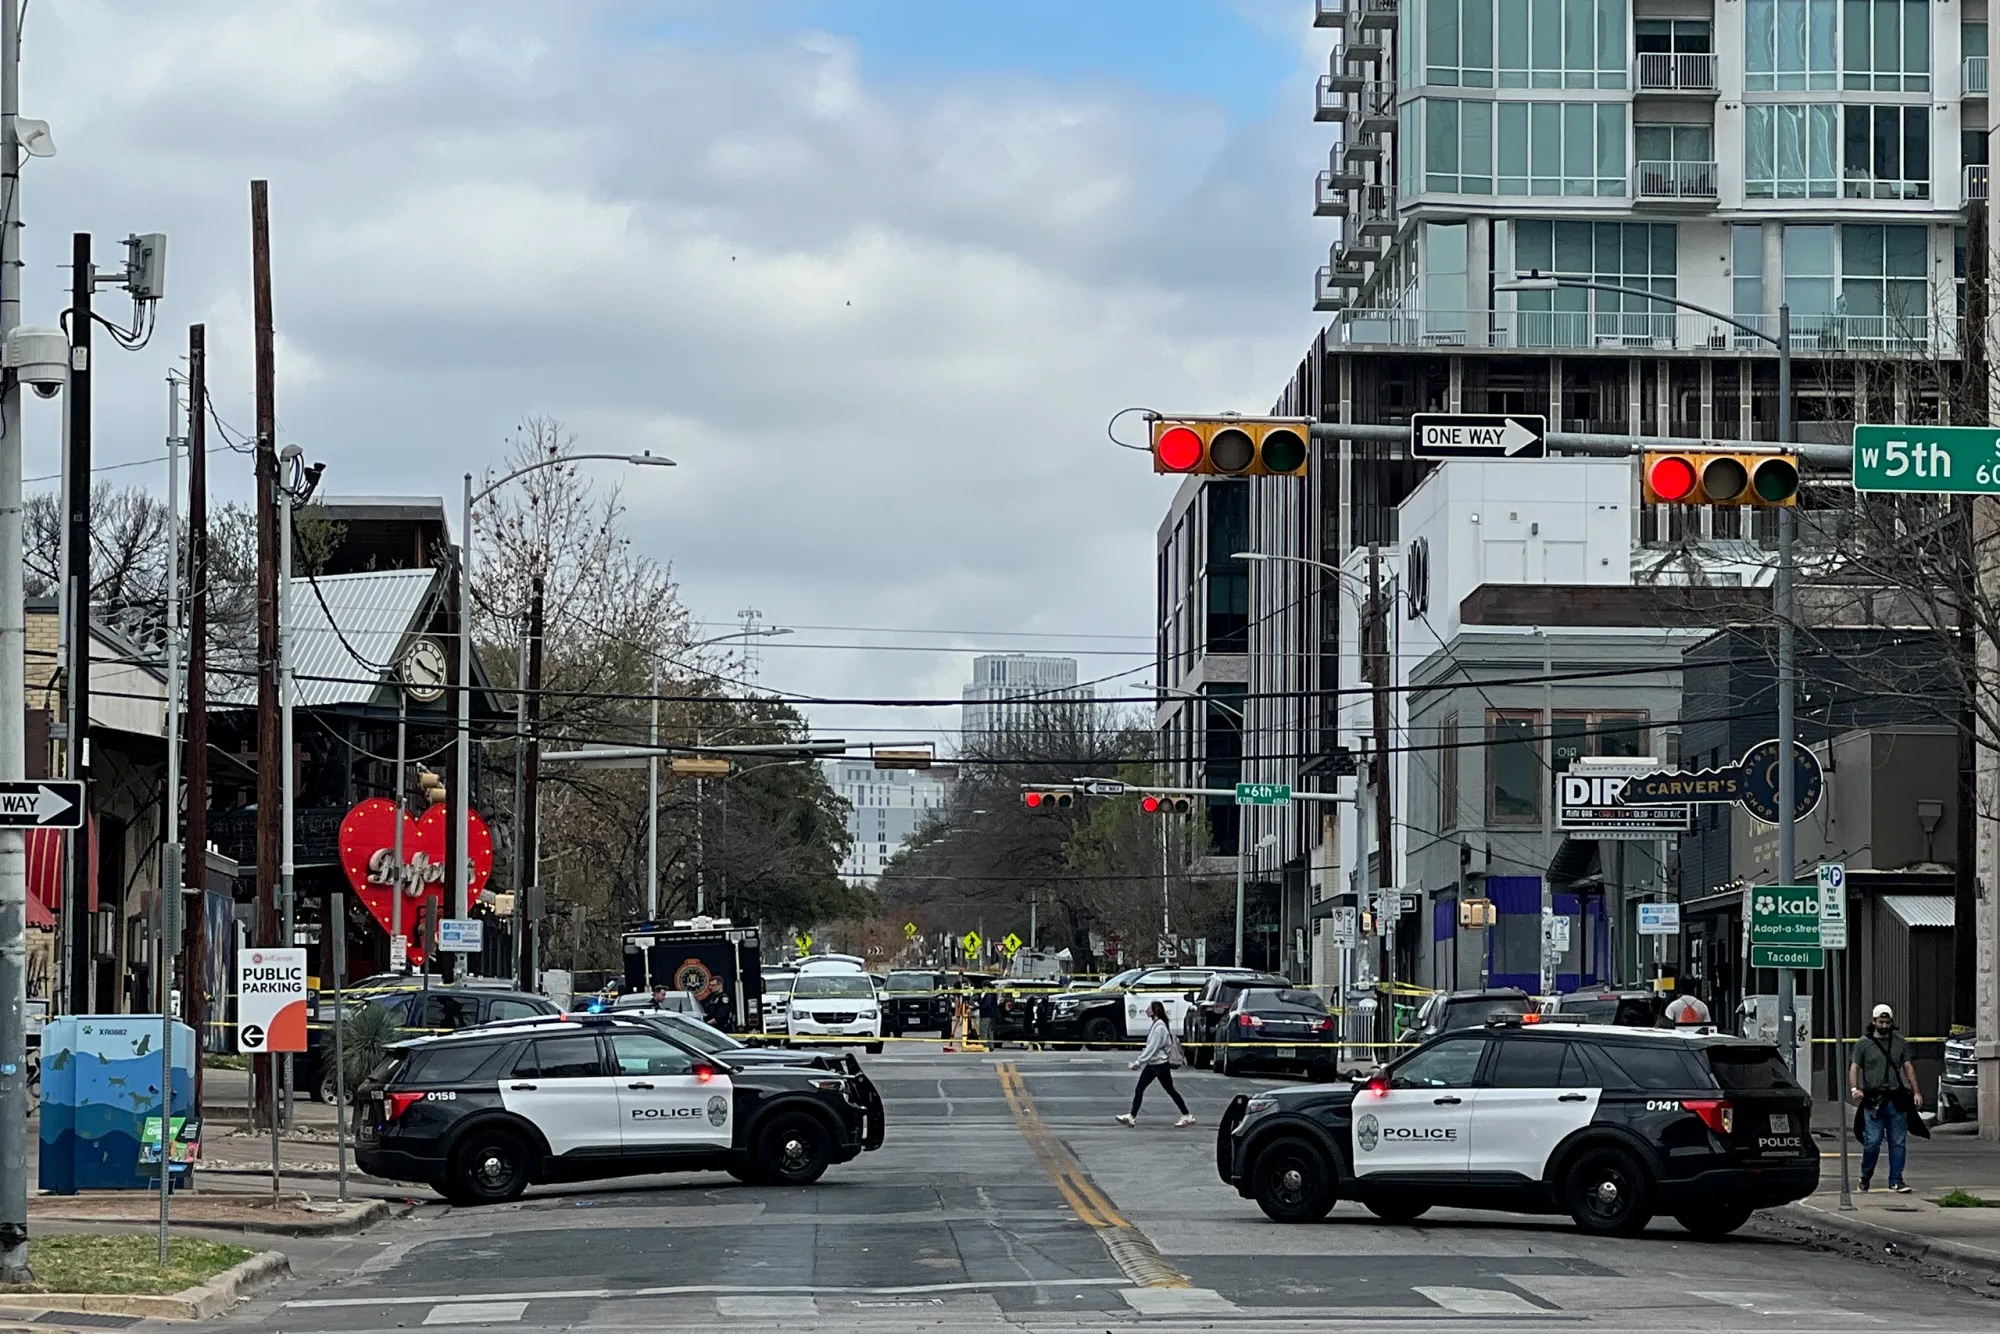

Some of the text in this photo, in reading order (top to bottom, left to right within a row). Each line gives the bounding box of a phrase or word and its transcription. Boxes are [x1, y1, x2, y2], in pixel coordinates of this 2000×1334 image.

[1427, 428, 1505, 445] ONE WAY
[1861, 440, 1951, 477] W 5th
[1251, 785, 1273, 798] 6th
[1565, 778, 1624, 806] DIR
[1646, 779, 1736, 796] CARVER'S
[2, 796, 39, 813] WAY
[1778, 896, 1820, 914] kab
[1767, 951, 1809, 963] Tacodeli
[242, 967, 302, 981] PUBLIC
[242, 982, 302, 993] PARKING
[427, 1091, 456, 1101] 0158
[1646, 1100, 1679, 1111] 0141
[632, 1107, 703, 1118] POLICE
[1383, 1128, 1457, 1139] POLICE
[1758, 1137, 1801, 1148] POLICE
